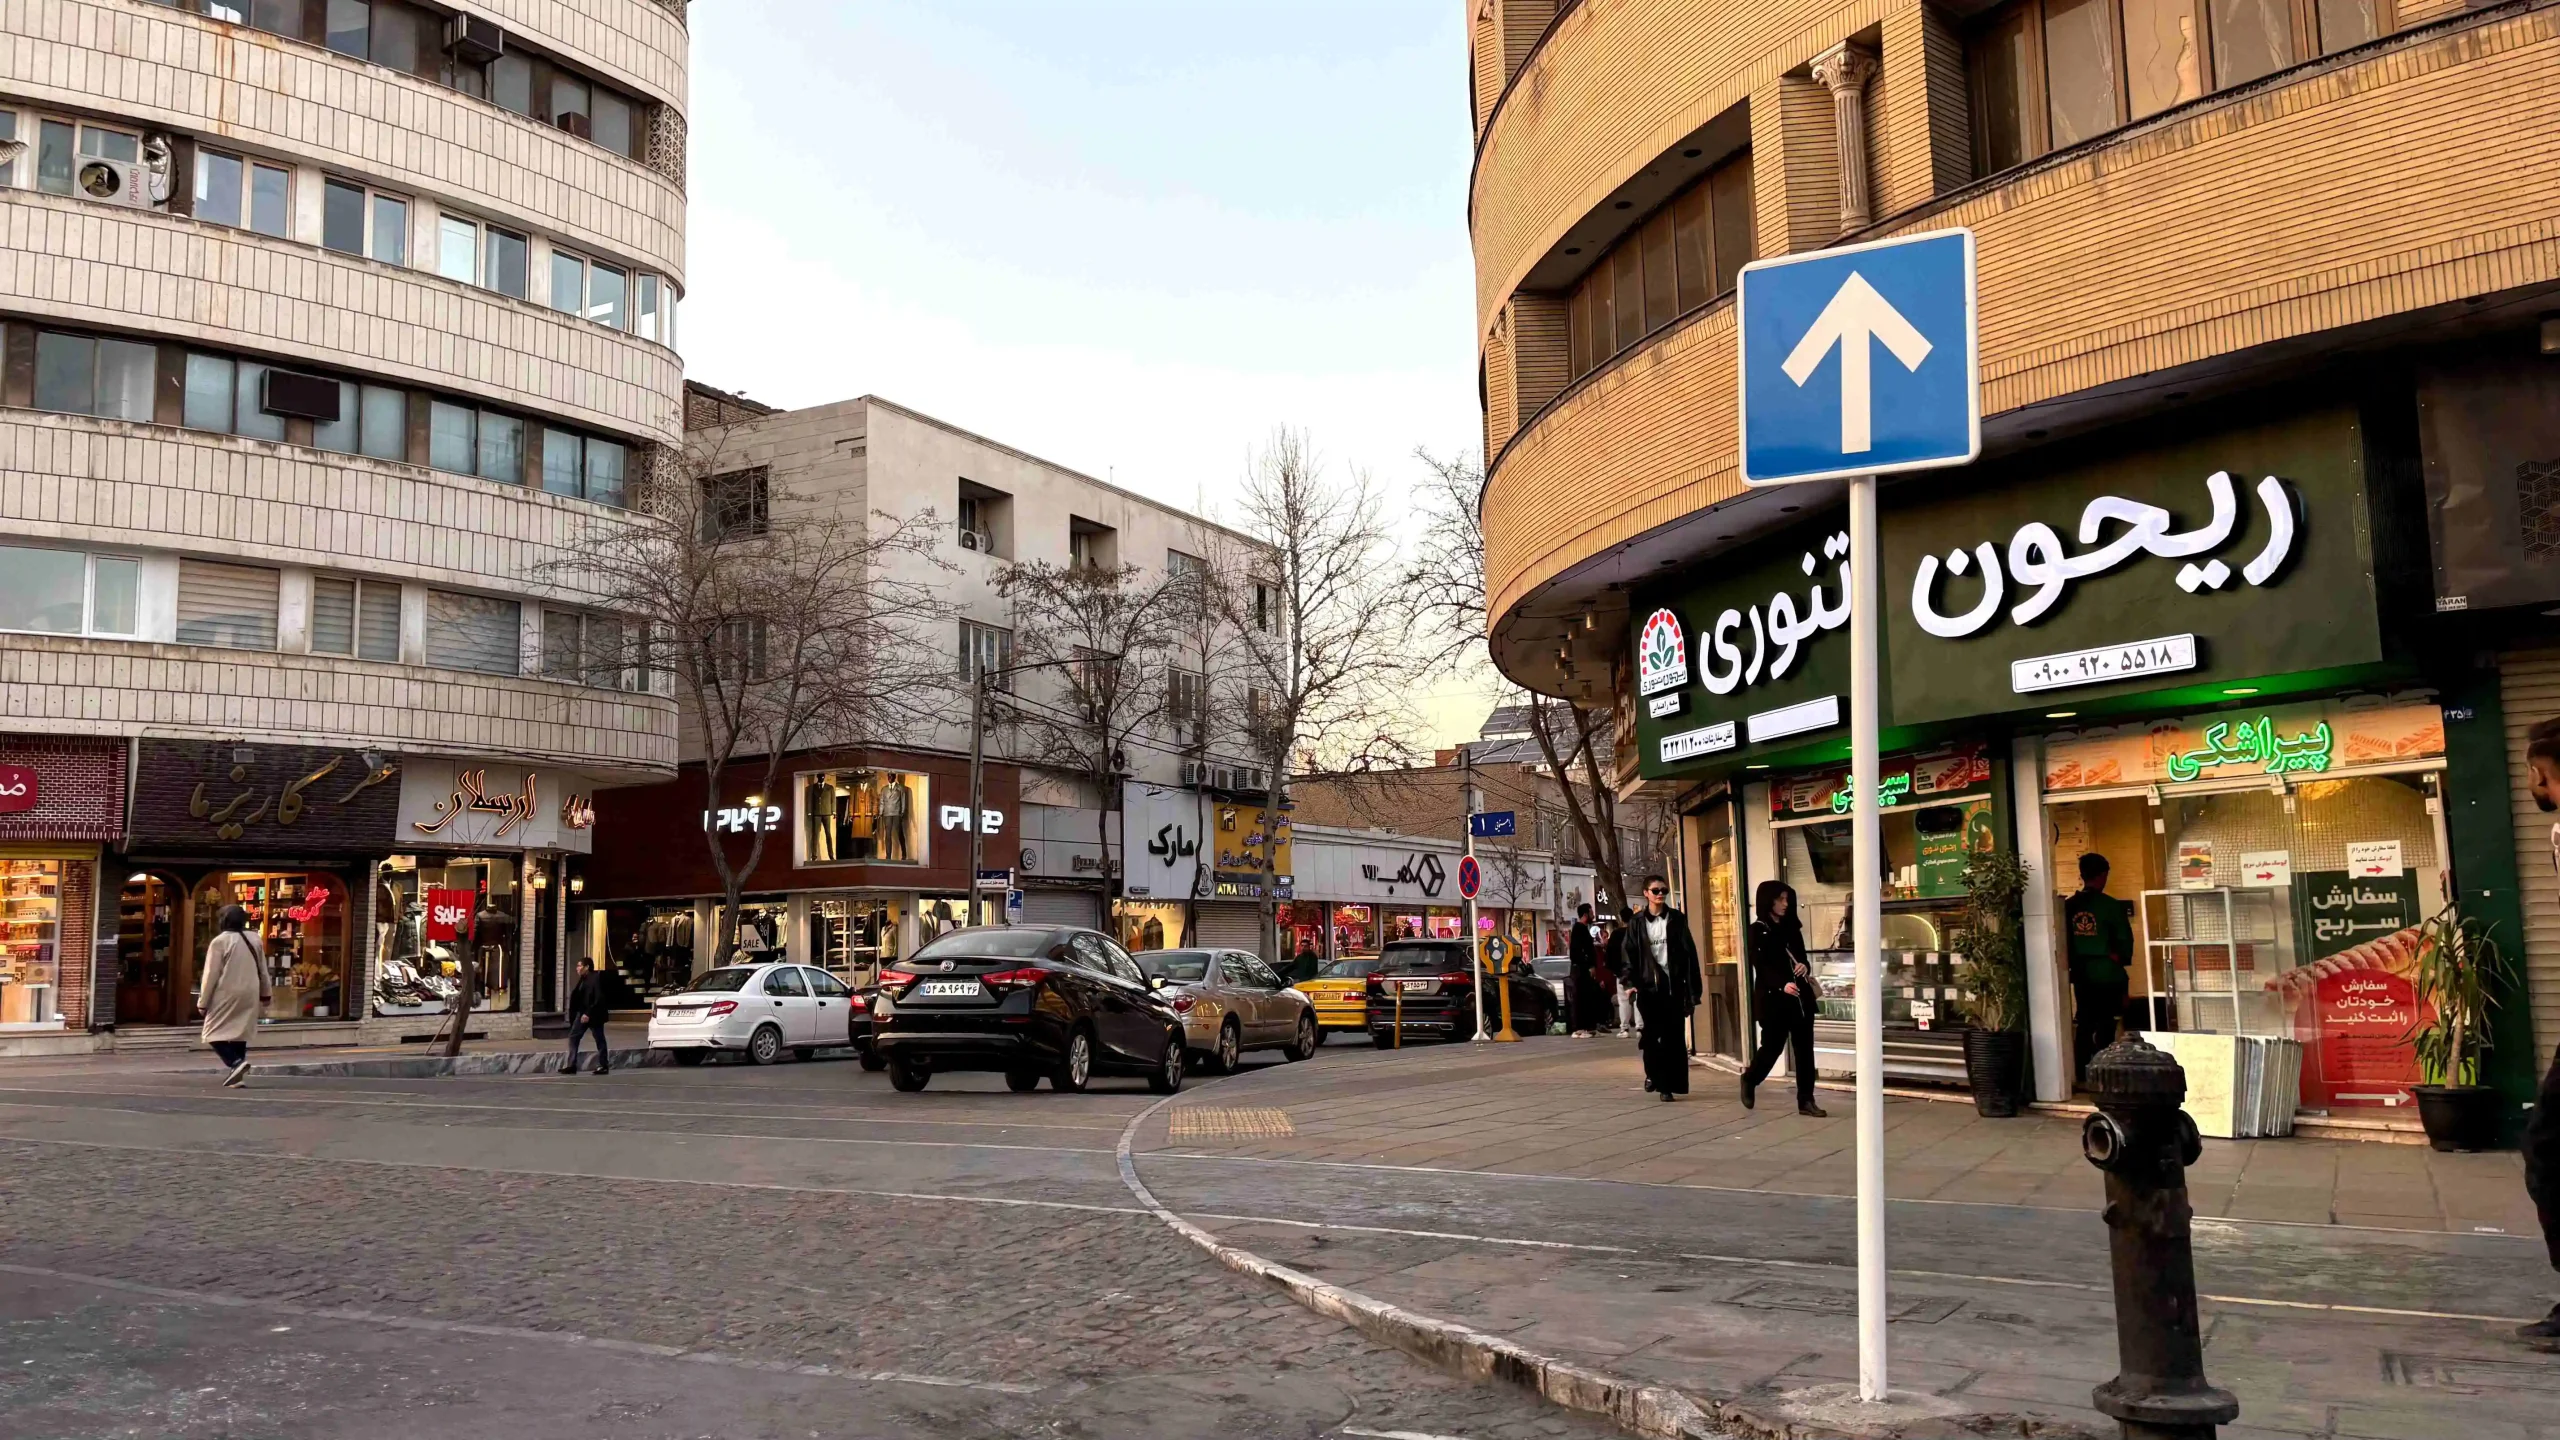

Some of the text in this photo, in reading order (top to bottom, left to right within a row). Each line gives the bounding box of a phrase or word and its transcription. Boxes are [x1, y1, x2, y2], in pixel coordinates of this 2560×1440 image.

[1912, 471, 2293, 637] ریحون
[1699, 530, 1851, 695] تنوری
[2079, 655, 2109, 676] ۹۲۰
[2121, 644, 2172, 670] ۵۵۱۸
[2167, 715, 2331, 782] پیراشکی
[414, 770, 537, 836] ارسلان
[1148, 823, 1195, 868] مارک
[1217, 883, 1238, 896] ATRA
[2312, 884, 2398, 911] سفارش
[2314, 915, 2400, 942] سریع
[743, 939, 760, 949] SALE
[2341, 979, 2388, 993] سفارش
[2336, 996, 2395, 1009] خودتان
[2325, 1010, 2408, 1025] را ثبت کنید
